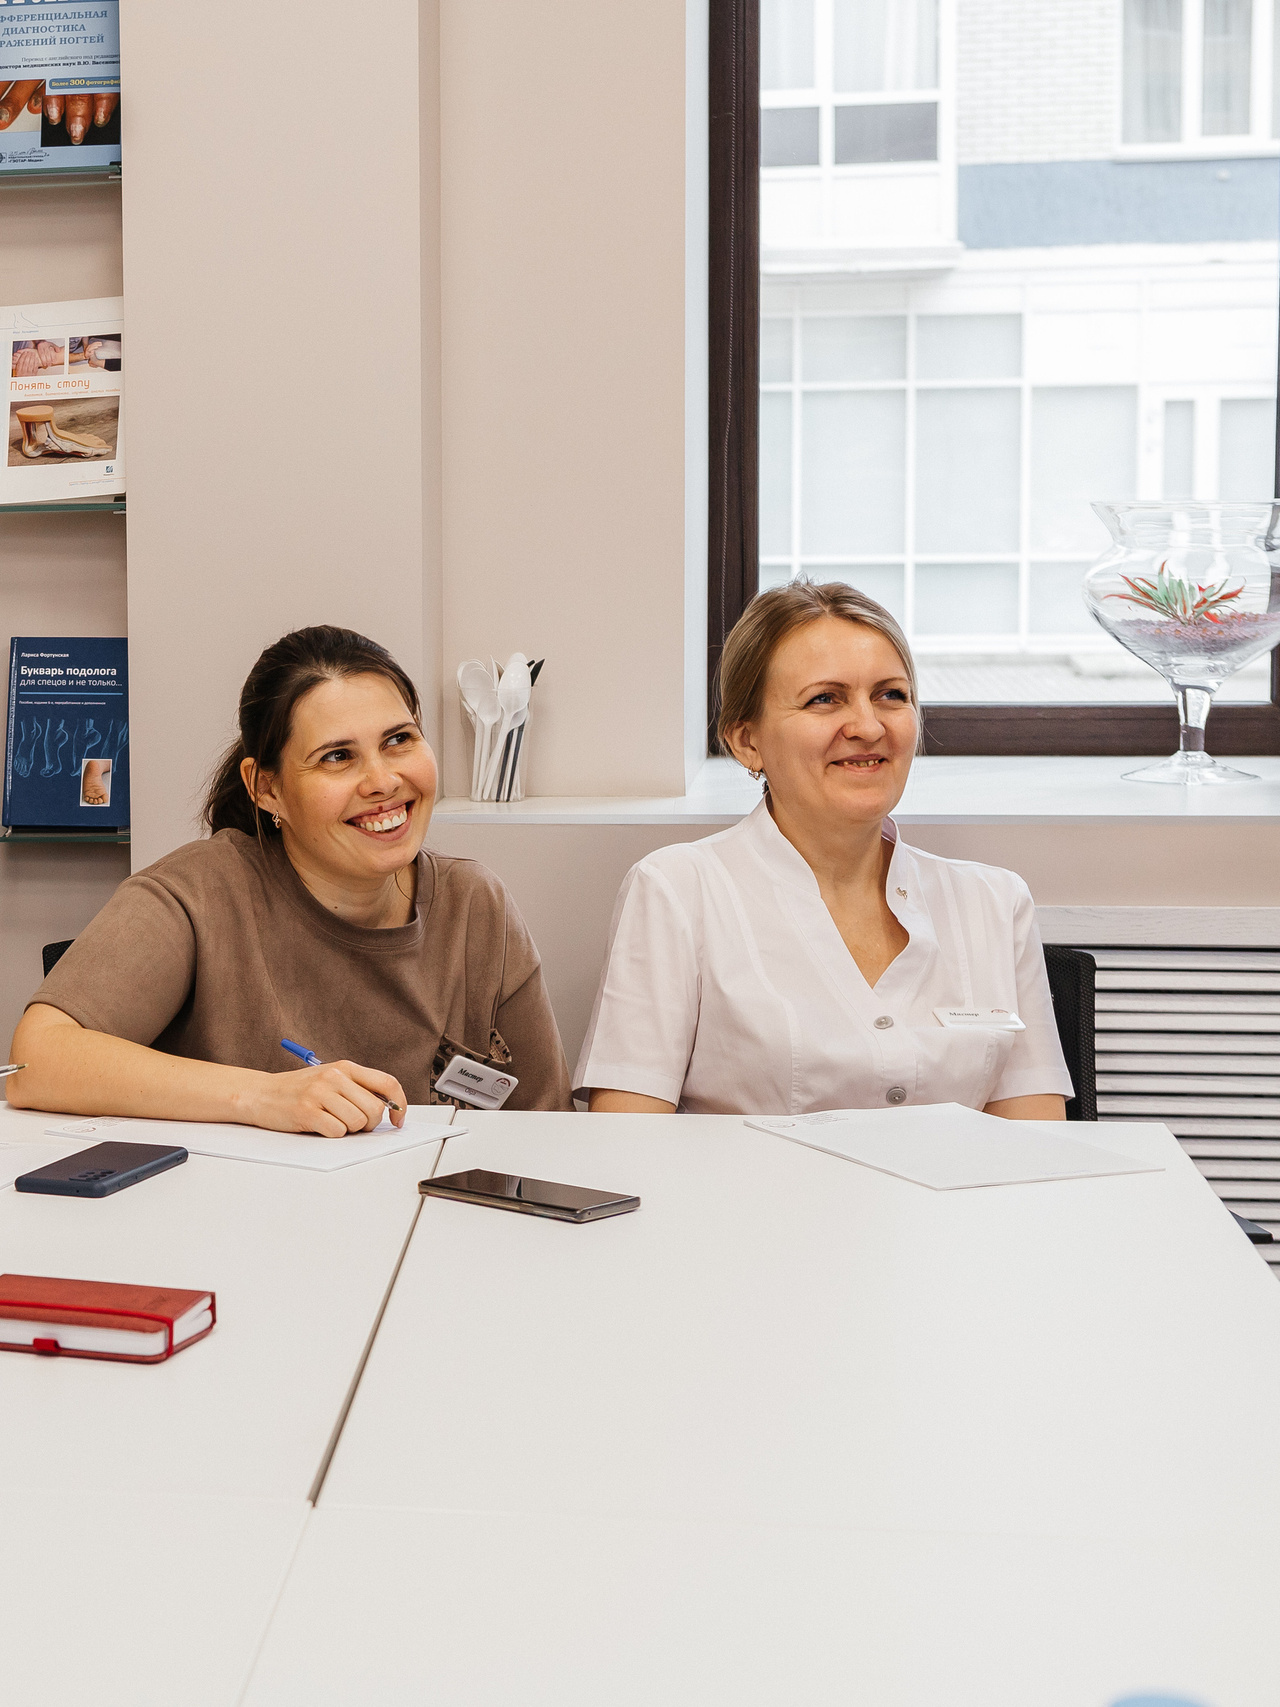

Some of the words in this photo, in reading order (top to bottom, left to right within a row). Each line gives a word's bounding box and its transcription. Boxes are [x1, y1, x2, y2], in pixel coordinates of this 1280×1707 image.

[2, 24, 86, 36] ДИАГНОСТИКА
[59, 33, 105, 45] НОГТЕЙ
[10, 381, 51, 391] Понять
[57, 379, 90, 390] стопу
[20, 665, 64, 677] Букварь
[66, 668, 117, 677] подолога
[37, 679, 67, 687] спецов
[458, 1068, 484, 1083] Мастер
